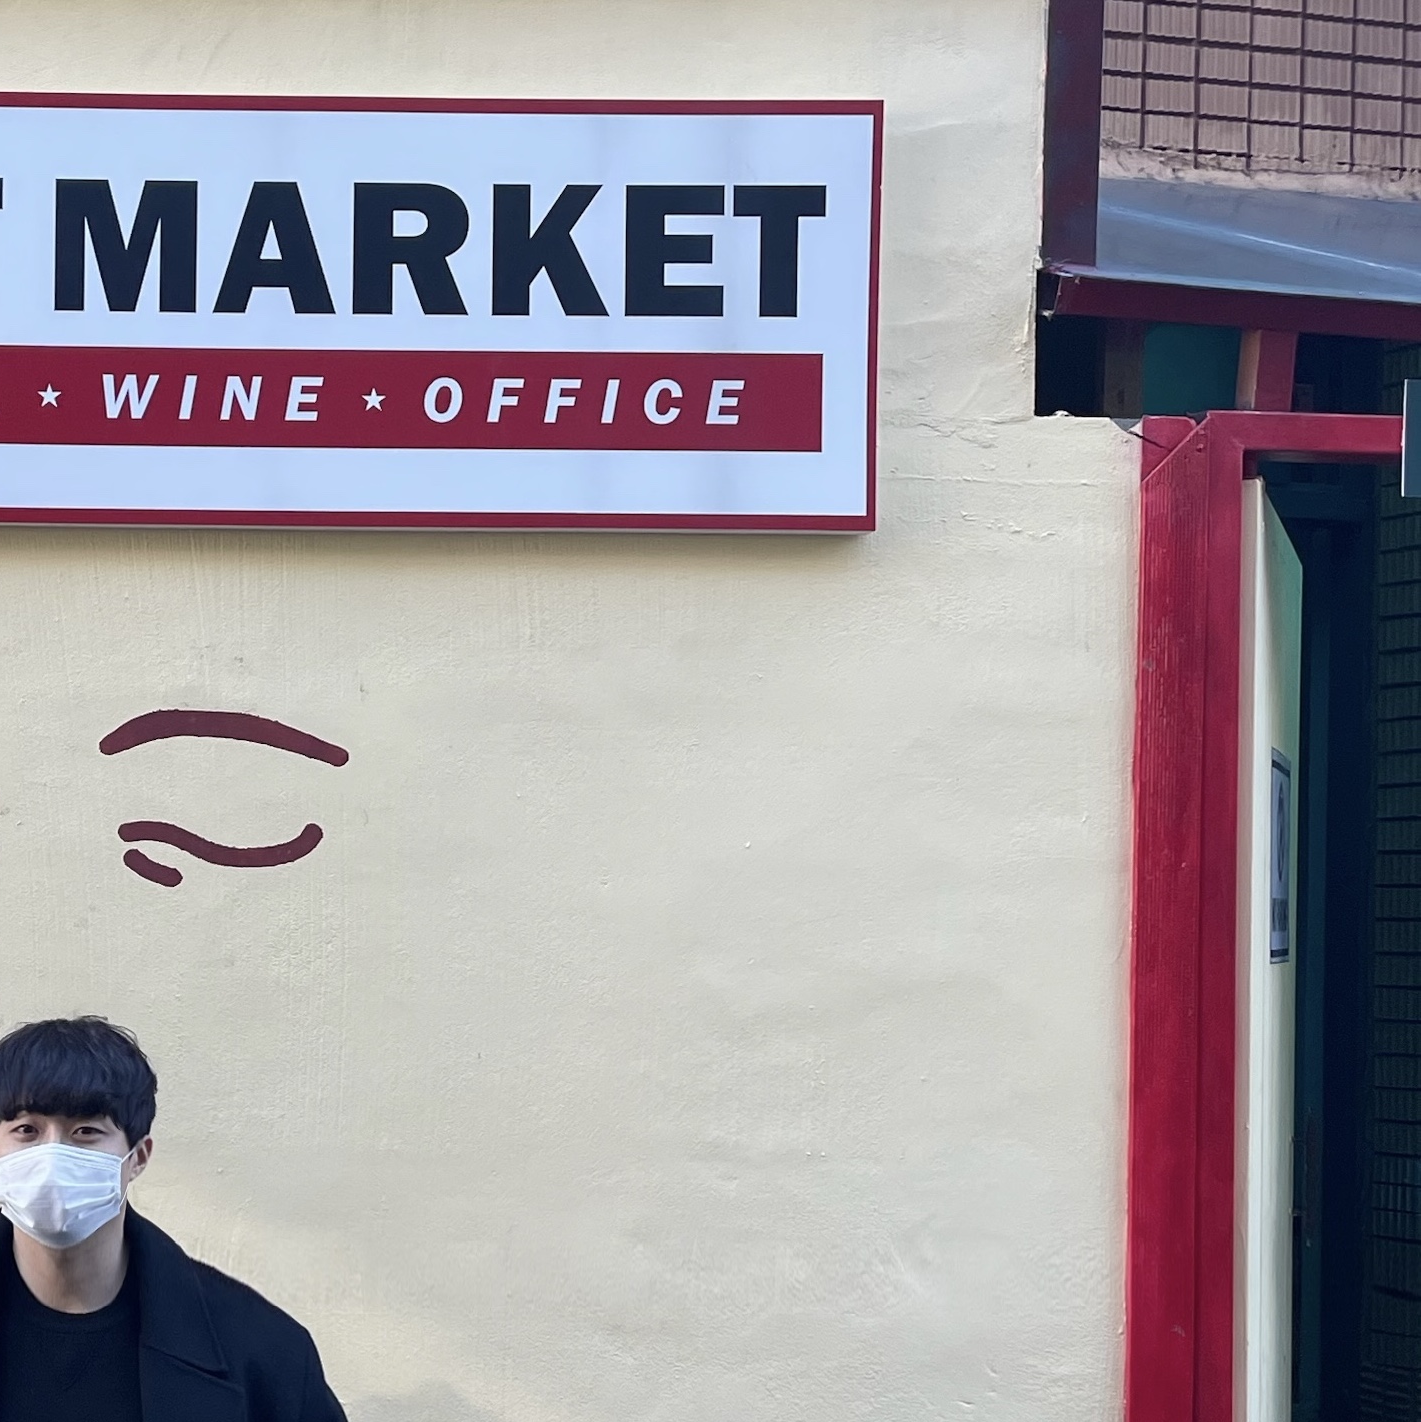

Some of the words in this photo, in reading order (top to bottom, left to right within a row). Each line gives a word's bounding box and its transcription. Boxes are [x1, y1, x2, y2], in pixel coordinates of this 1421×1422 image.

[53, 178, 827, 318] MARKET
[102, 373, 325, 423] WINE
[423, 376, 746, 426] OFFICE
